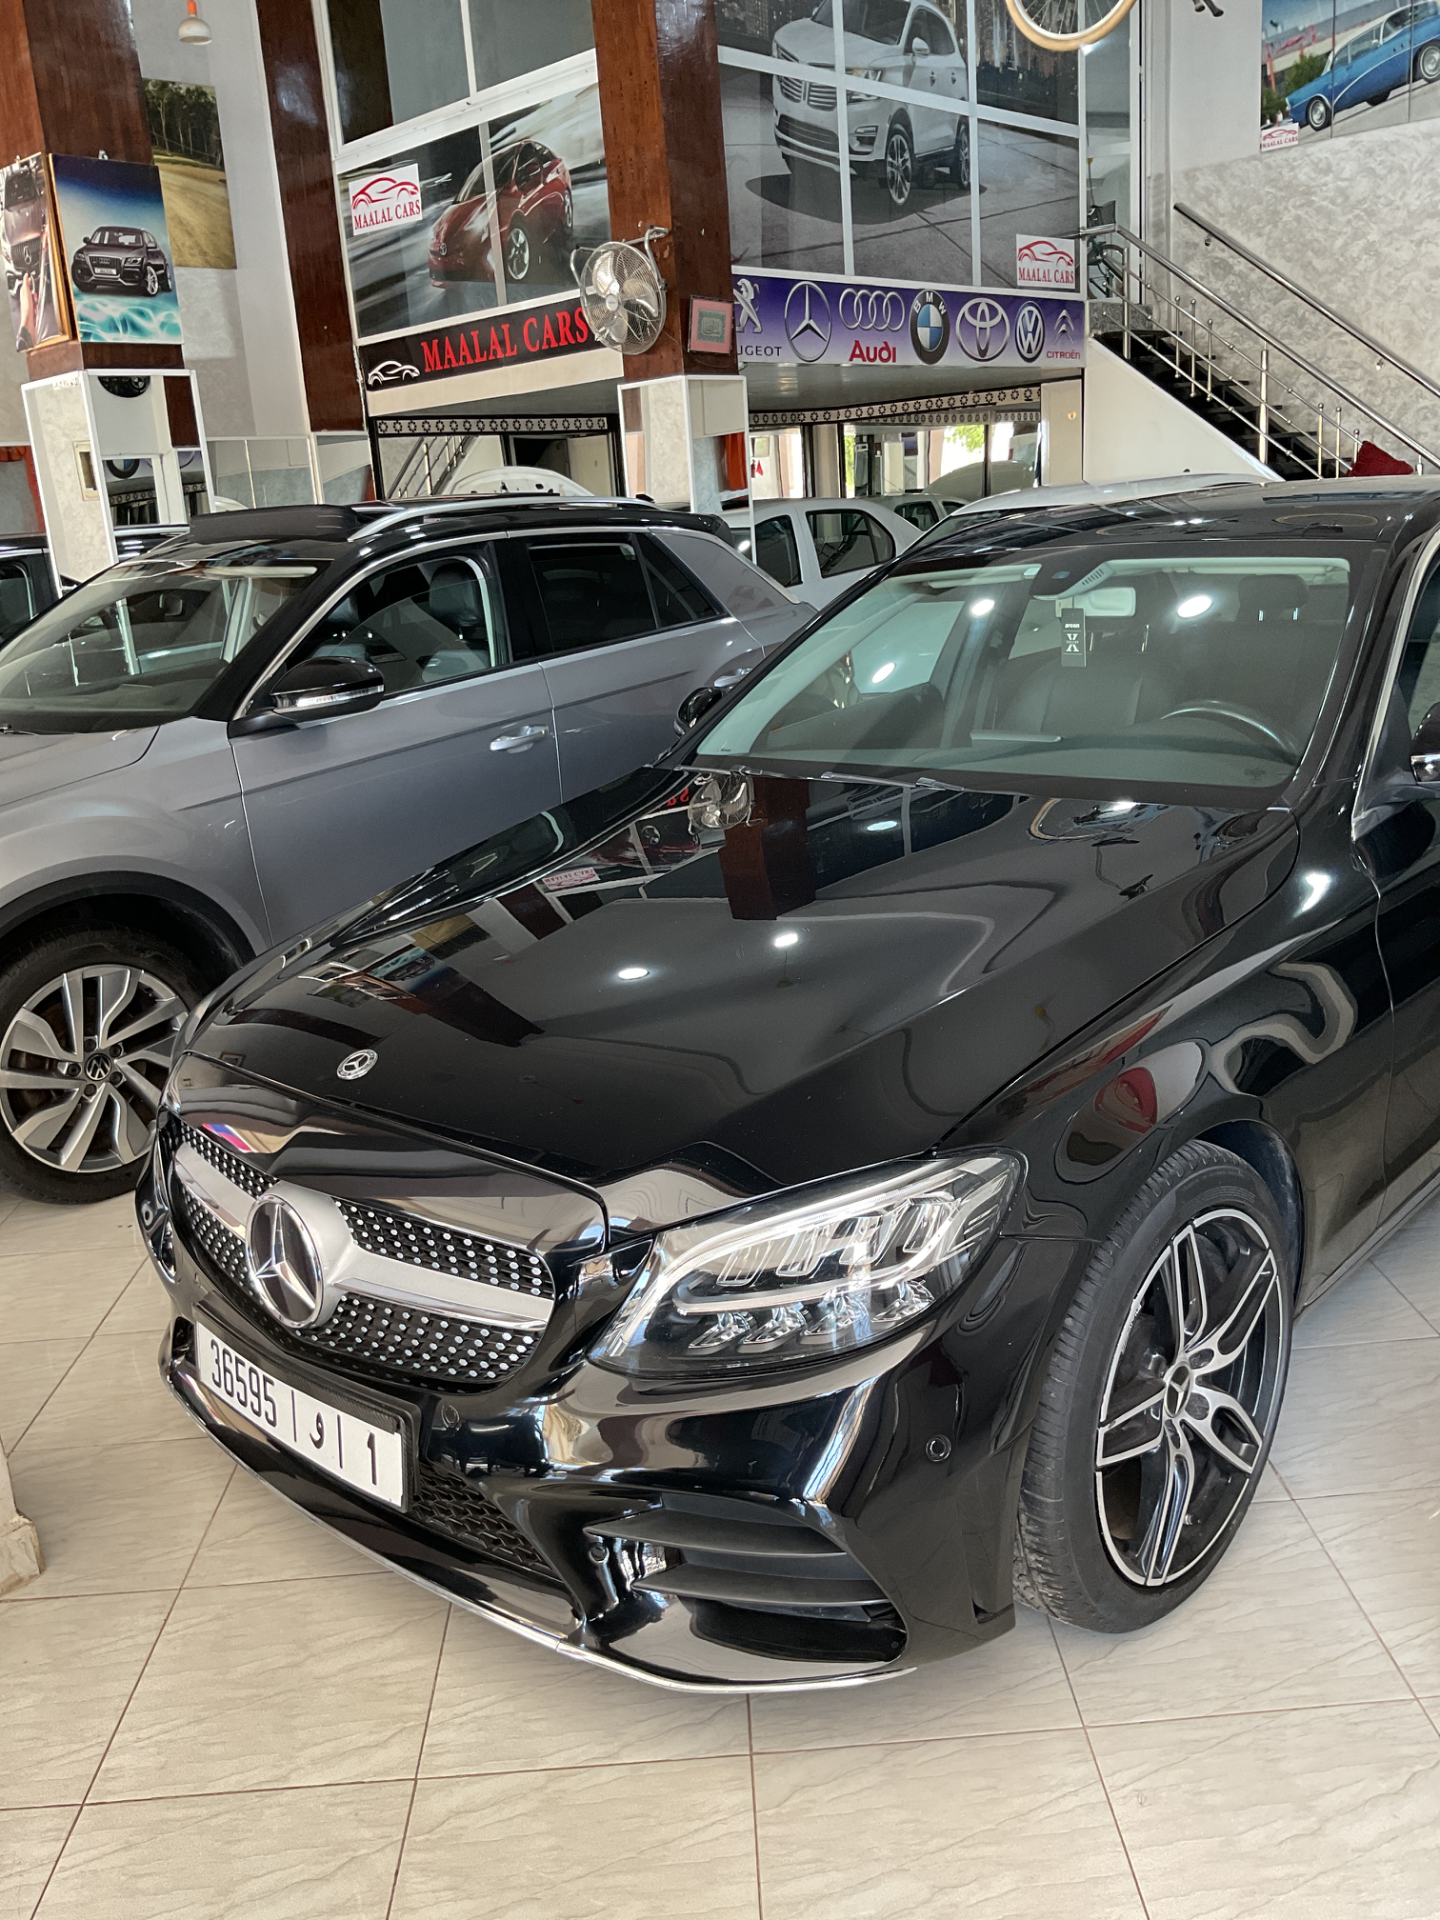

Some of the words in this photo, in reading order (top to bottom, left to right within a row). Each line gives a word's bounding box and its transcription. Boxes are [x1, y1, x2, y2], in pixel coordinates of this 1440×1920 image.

[354, 207, 393, 230] MAALAL
[395, 199, 421, 220] CARS
[1018, 267, 1052, 282] MAALAL
[1054, 269, 1075, 284] CARS
[421, 324, 518, 373] MAALAL
[523, 307, 589, 352] CARS
[737, 345, 783, 357] UGEOT
[848, 340, 897, 363] Audi
[211, 1339, 277, 1428] 36595
[309, 1411, 325, 1450] و
[366, 1431, 377, 1486] 1
